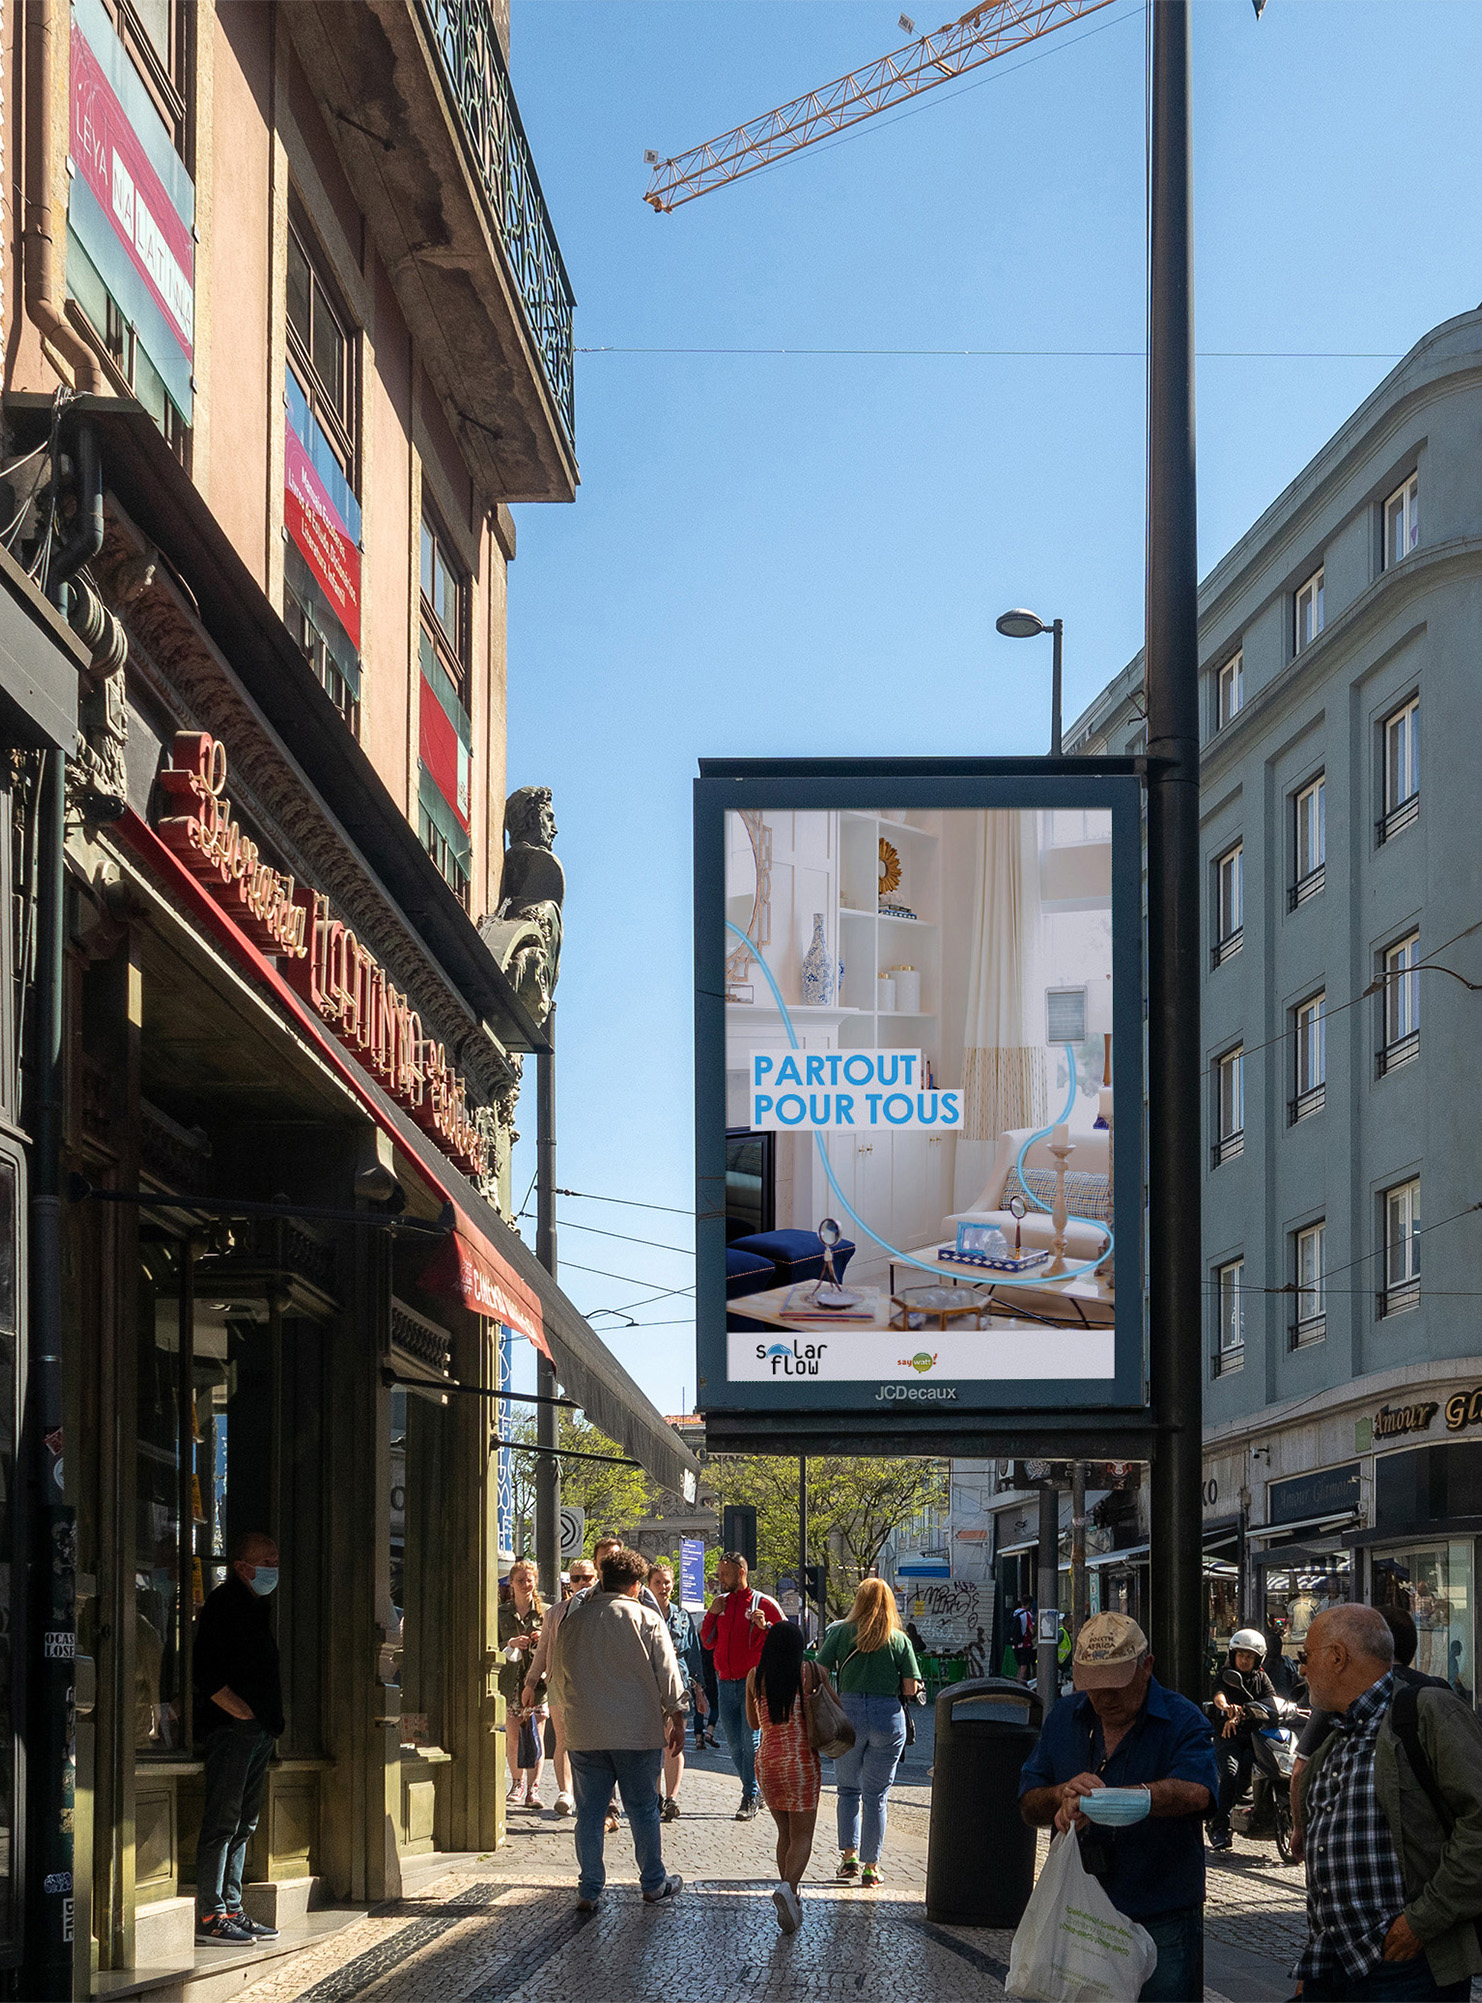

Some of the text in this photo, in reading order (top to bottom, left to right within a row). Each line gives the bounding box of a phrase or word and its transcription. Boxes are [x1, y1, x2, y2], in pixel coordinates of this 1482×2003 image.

[76, 101, 191, 326] LEYA NA LATINA
[755, 1055, 917, 1086] PARTOUT
[755, 1092, 960, 1125] POUR TOUS
[771, 1356, 819, 1375] flow
[875, 1385, 957, 1401] JCDecaux
[1375, 1388, 1482, 1438] Amour Gl
